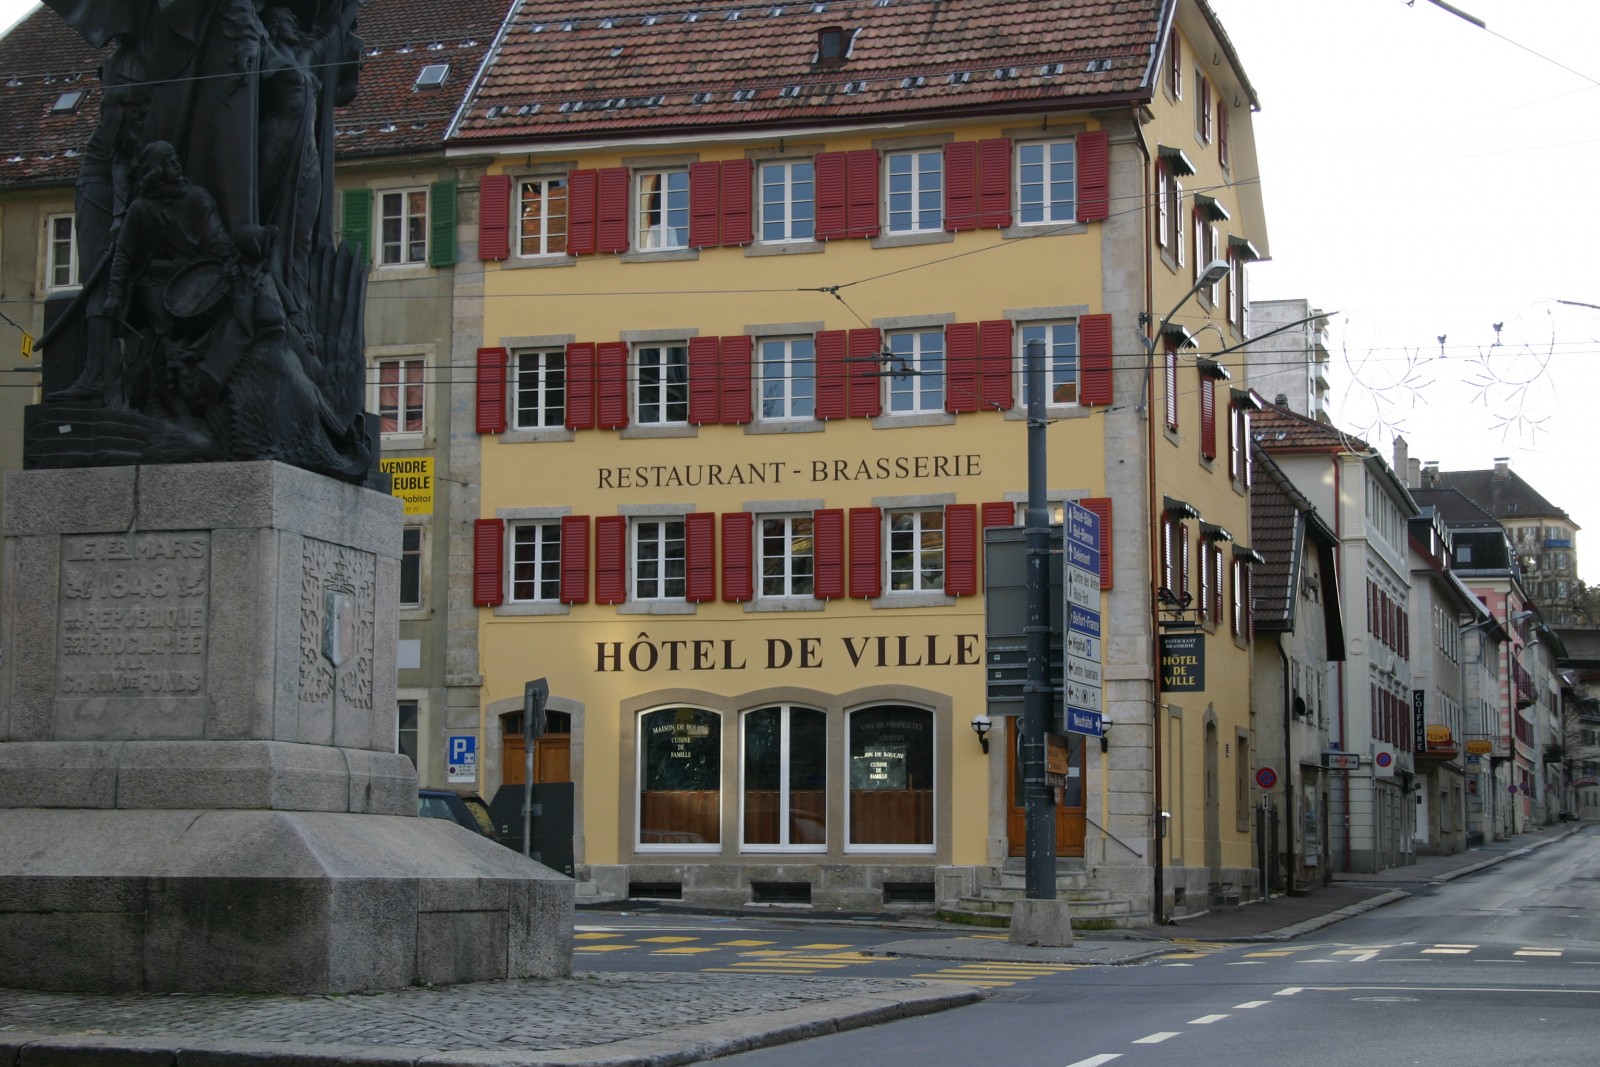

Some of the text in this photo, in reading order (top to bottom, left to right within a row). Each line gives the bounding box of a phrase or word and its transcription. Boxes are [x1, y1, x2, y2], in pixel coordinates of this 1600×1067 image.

[381, 461, 427, 474] VENDRE
[597, 462, 786, 489] RESTAURANT
[810, 454, 982, 482] BRASSERIE
[67, 540, 96, 561] LE
[133, 538, 205, 560] MARS
[100, 568, 170, 599] 1848
[1072, 611, 1100, 632] Belfort-France
[594, 632, 981, 672] HÔTEL DE VILLE
[1163, 654, 1198, 666] HÔTEL
[1164, 676, 1196, 686] VILLE
[1173, 666, 1187, 675] DE
[652, 724, 675, 734] MAISON
[1415, 693, 1423, 751] COIFFURE
[453, 738, 467, 760] P
